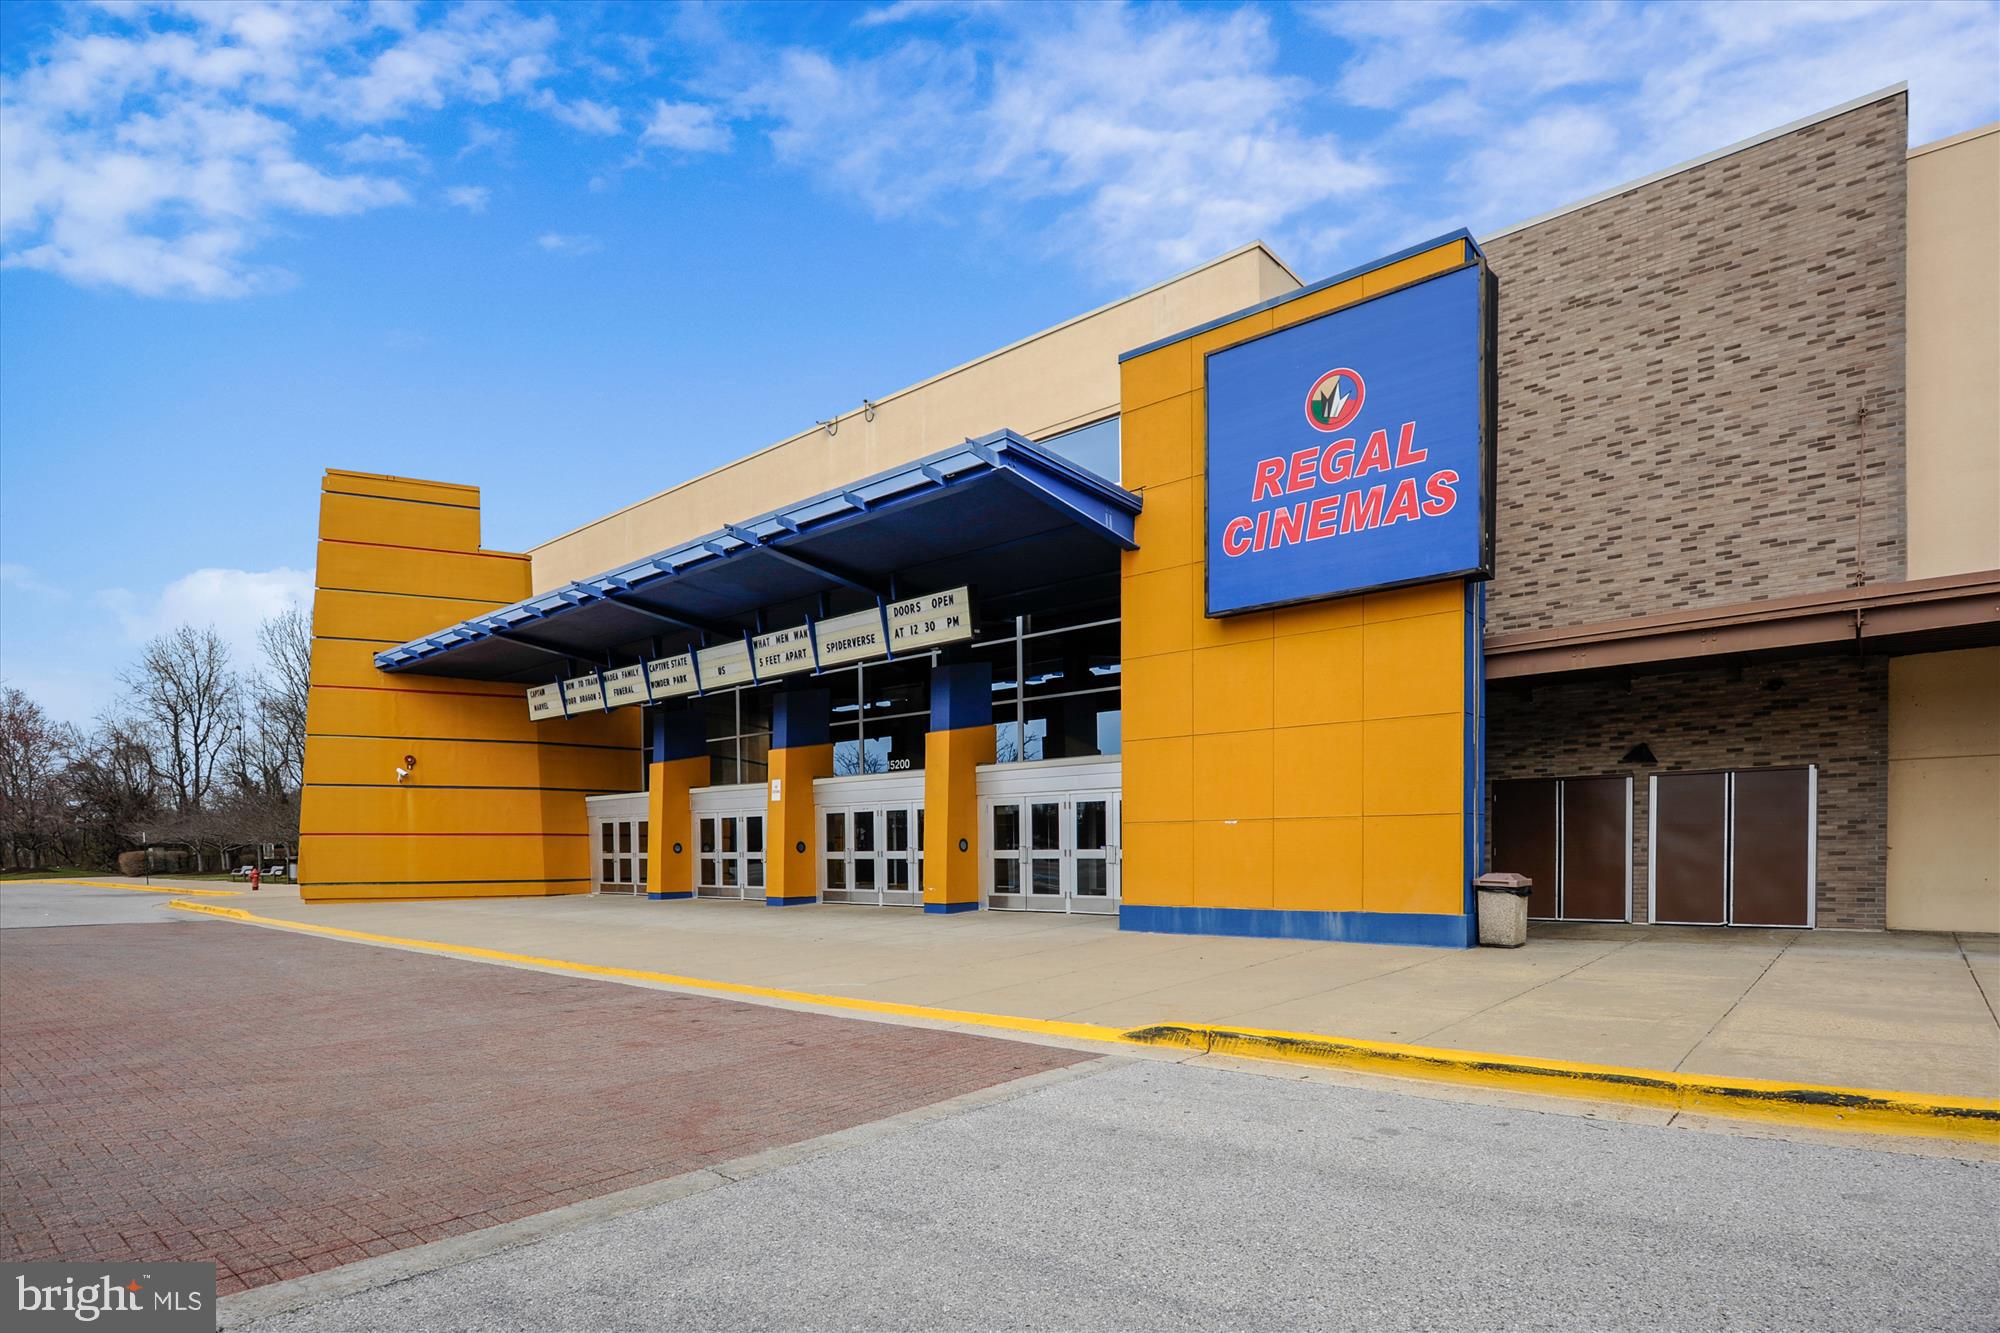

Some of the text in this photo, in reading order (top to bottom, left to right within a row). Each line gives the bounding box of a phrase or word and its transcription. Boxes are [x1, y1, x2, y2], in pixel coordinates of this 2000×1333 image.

[1251, 421, 1428, 502] REGAL
[1223, 470, 1460, 557] CINEMAS
[893, 594, 955, 617] DOORS OPEN
[894, 615, 960, 640] AT 12 30 PM
[753, 637, 770, 649] WHAT
[775, 633, 789, 645] MEN
[825, 633, 876, 654] SPIDERVERSE
[648, 656, 688, 673] CAPTIVE STATE
[759, 648, 807, 667] 5 FEET APART
[621, 667, 639, 679] FAMILY
[717, 665, 726, 676] US
[578, 680, 584, 688] TO
[585, 677, 598, 687] TRAIN
[650, 674, 688, 689] WONDER PARK
[580, 694, 597, 703] DRAGON
[613, 685, 635, 697] FUNERAL
[887, 758, 911, 770] 15200
